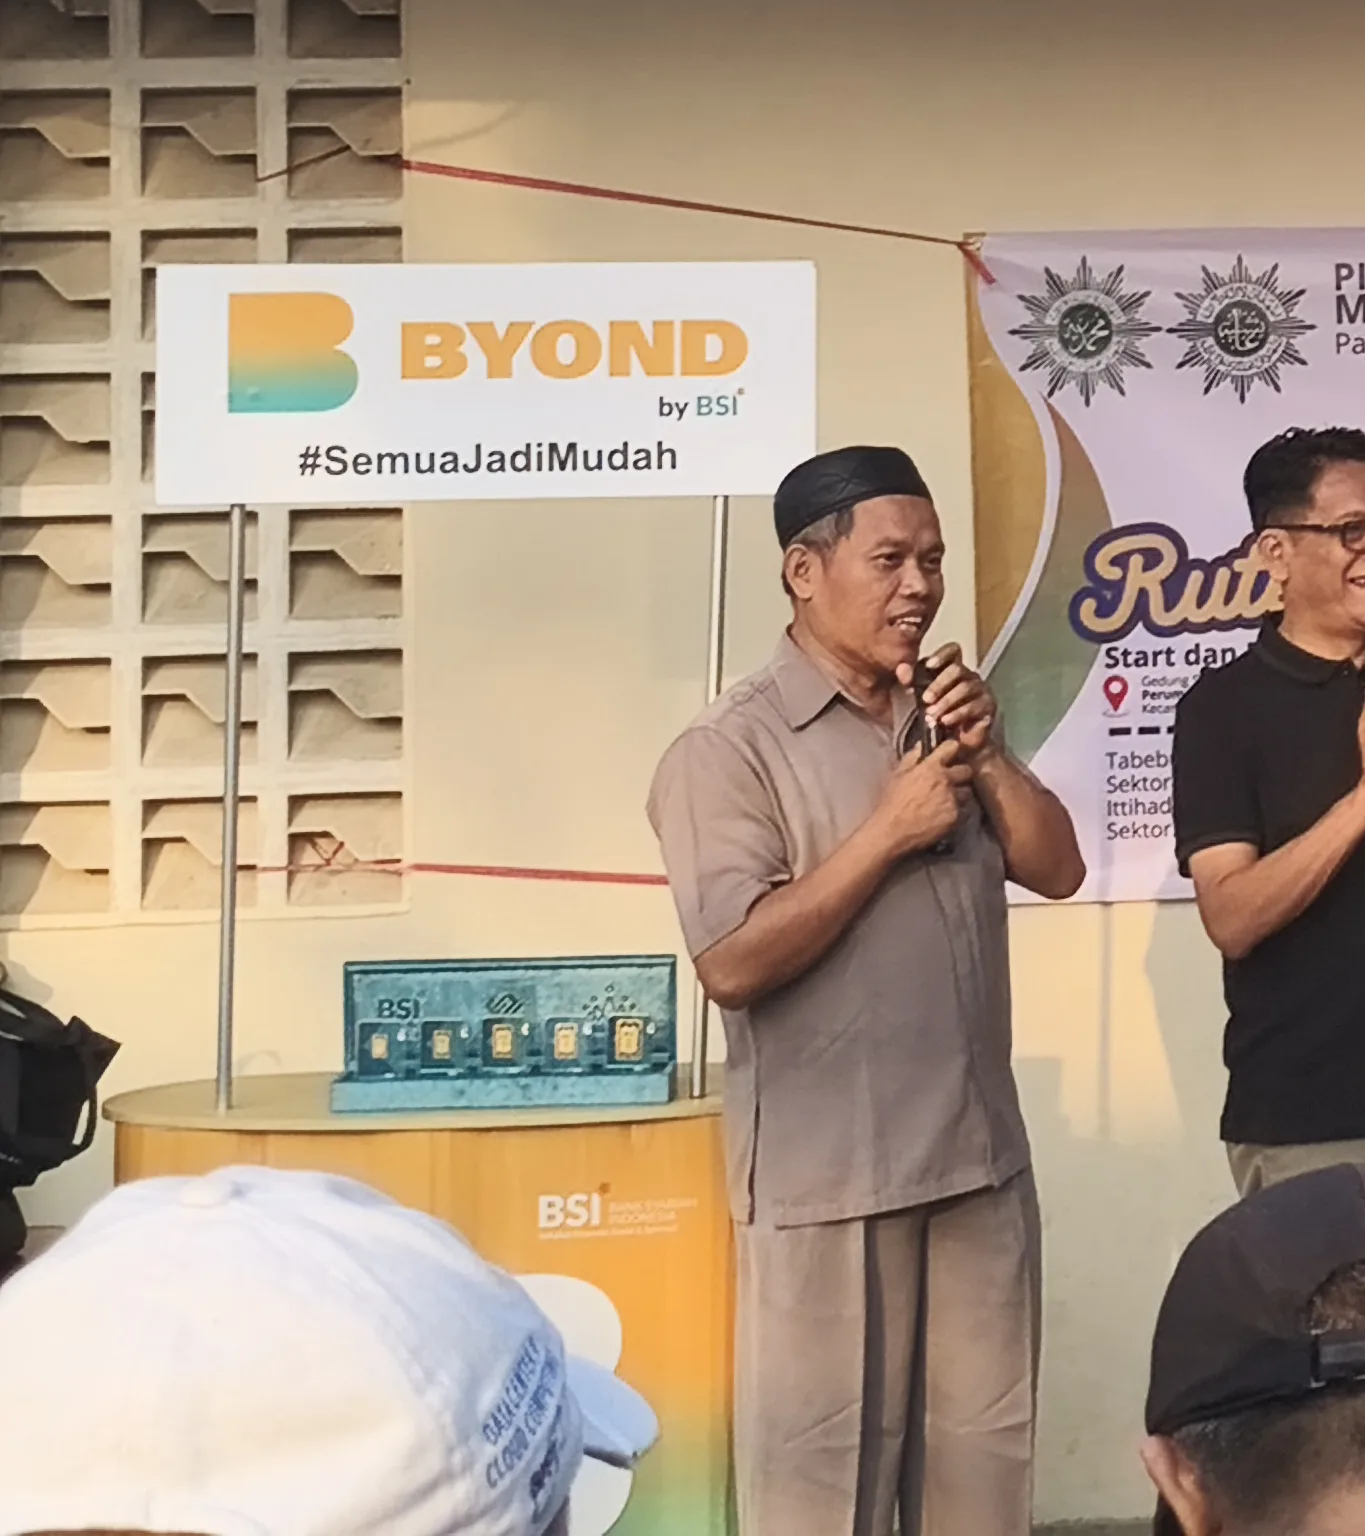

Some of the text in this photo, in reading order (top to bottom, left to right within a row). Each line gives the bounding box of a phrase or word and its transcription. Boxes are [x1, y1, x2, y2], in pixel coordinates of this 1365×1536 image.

[401, 320, 749, 379] BYOND
[658, 394, 739, 419] by BSI
[299, 441, 678, 476] #SemuaJadiMudah
[1105, 643, 1236, 669] Start dan
[1105, 750, 1171, 770] Tabeb
[1106, 775, 1172, 794] Sektor
[1106, 821, 1172, 841] Sektor
[377, 997, 421, 1020] BSI
[538, 1192, 601, 1229] BSI
